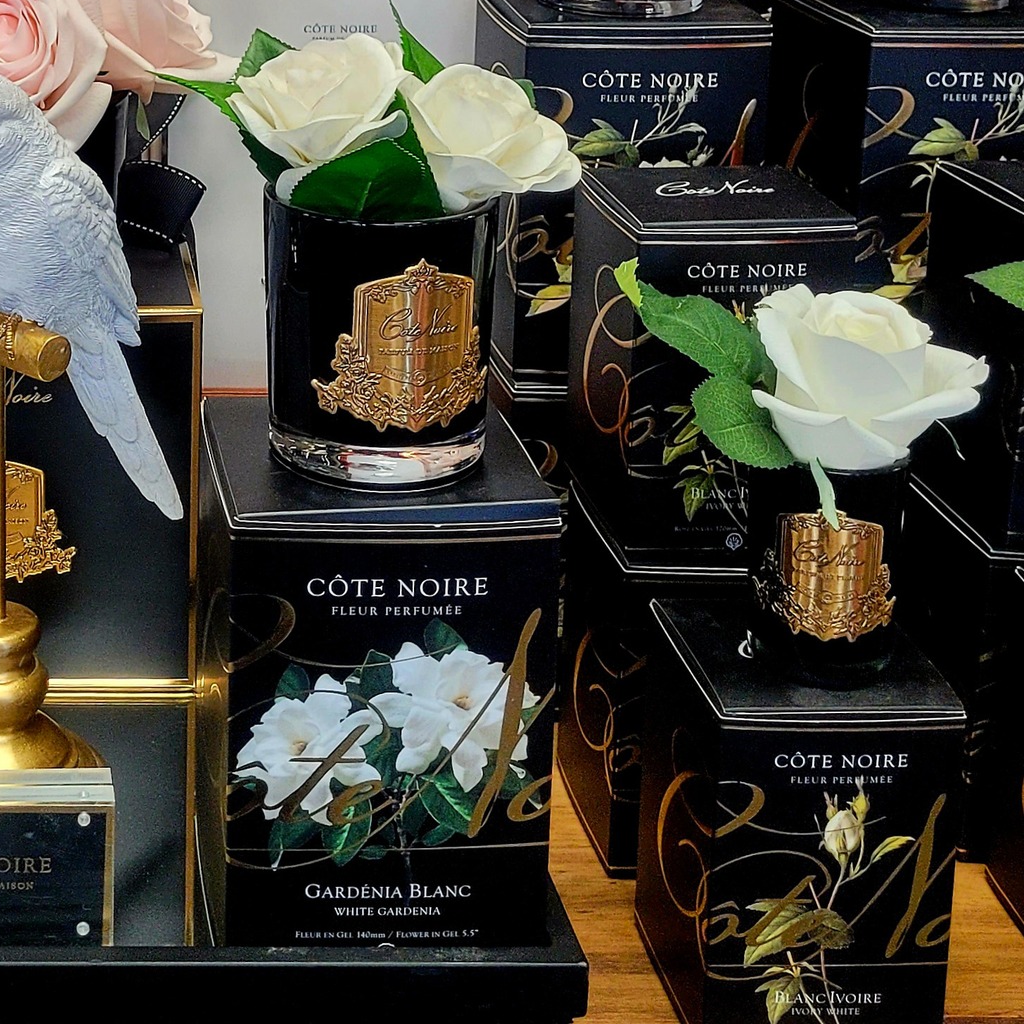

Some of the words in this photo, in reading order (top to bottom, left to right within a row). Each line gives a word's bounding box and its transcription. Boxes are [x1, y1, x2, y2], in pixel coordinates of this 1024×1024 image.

[304, 23, 336, 34] CÔTE
[343, 25, 377, 34] NOIRE
[582, 69, 642, 88] CÔTE
[650, 72, 719, 88] NOIRE
[925, 68, 985, 88] CÔTE
[600, 94, 636, 103] FLEUR
[943, 93, 978, 102] FLEUR
[710, 179, 776, 196] Noire
[687, 262, 740, 278] CÔTE
[747, 263, 808, 278] NOIRE
[703, 285, 735, 293] FLEUR
[691, 486, 736, 499] BLANC
[306, 574, 386, 597] CÔTE
[397, 577, 488, 597] NOIRE
[331, 606, 378, 616] FLEUR
[385, 604, 462, 616] PERFUMÉE
[774, 751, 833, 769] CÔTE
[841, 753, 908, 769] NOIRE
[790, 776, 827, 784] FLEUR
[304, 883, 403, 899] GARDÉNIA
[409, 883, 472, 898] BLANC
[334, 907, 374, 916] WHITE
[377, 906, 441, 916] GARDENIA
[442, 930, 459, 938] GEL
[775, 991, 826, 1004] BLANC
[830, 991, 882, 1004] IVOIRE
